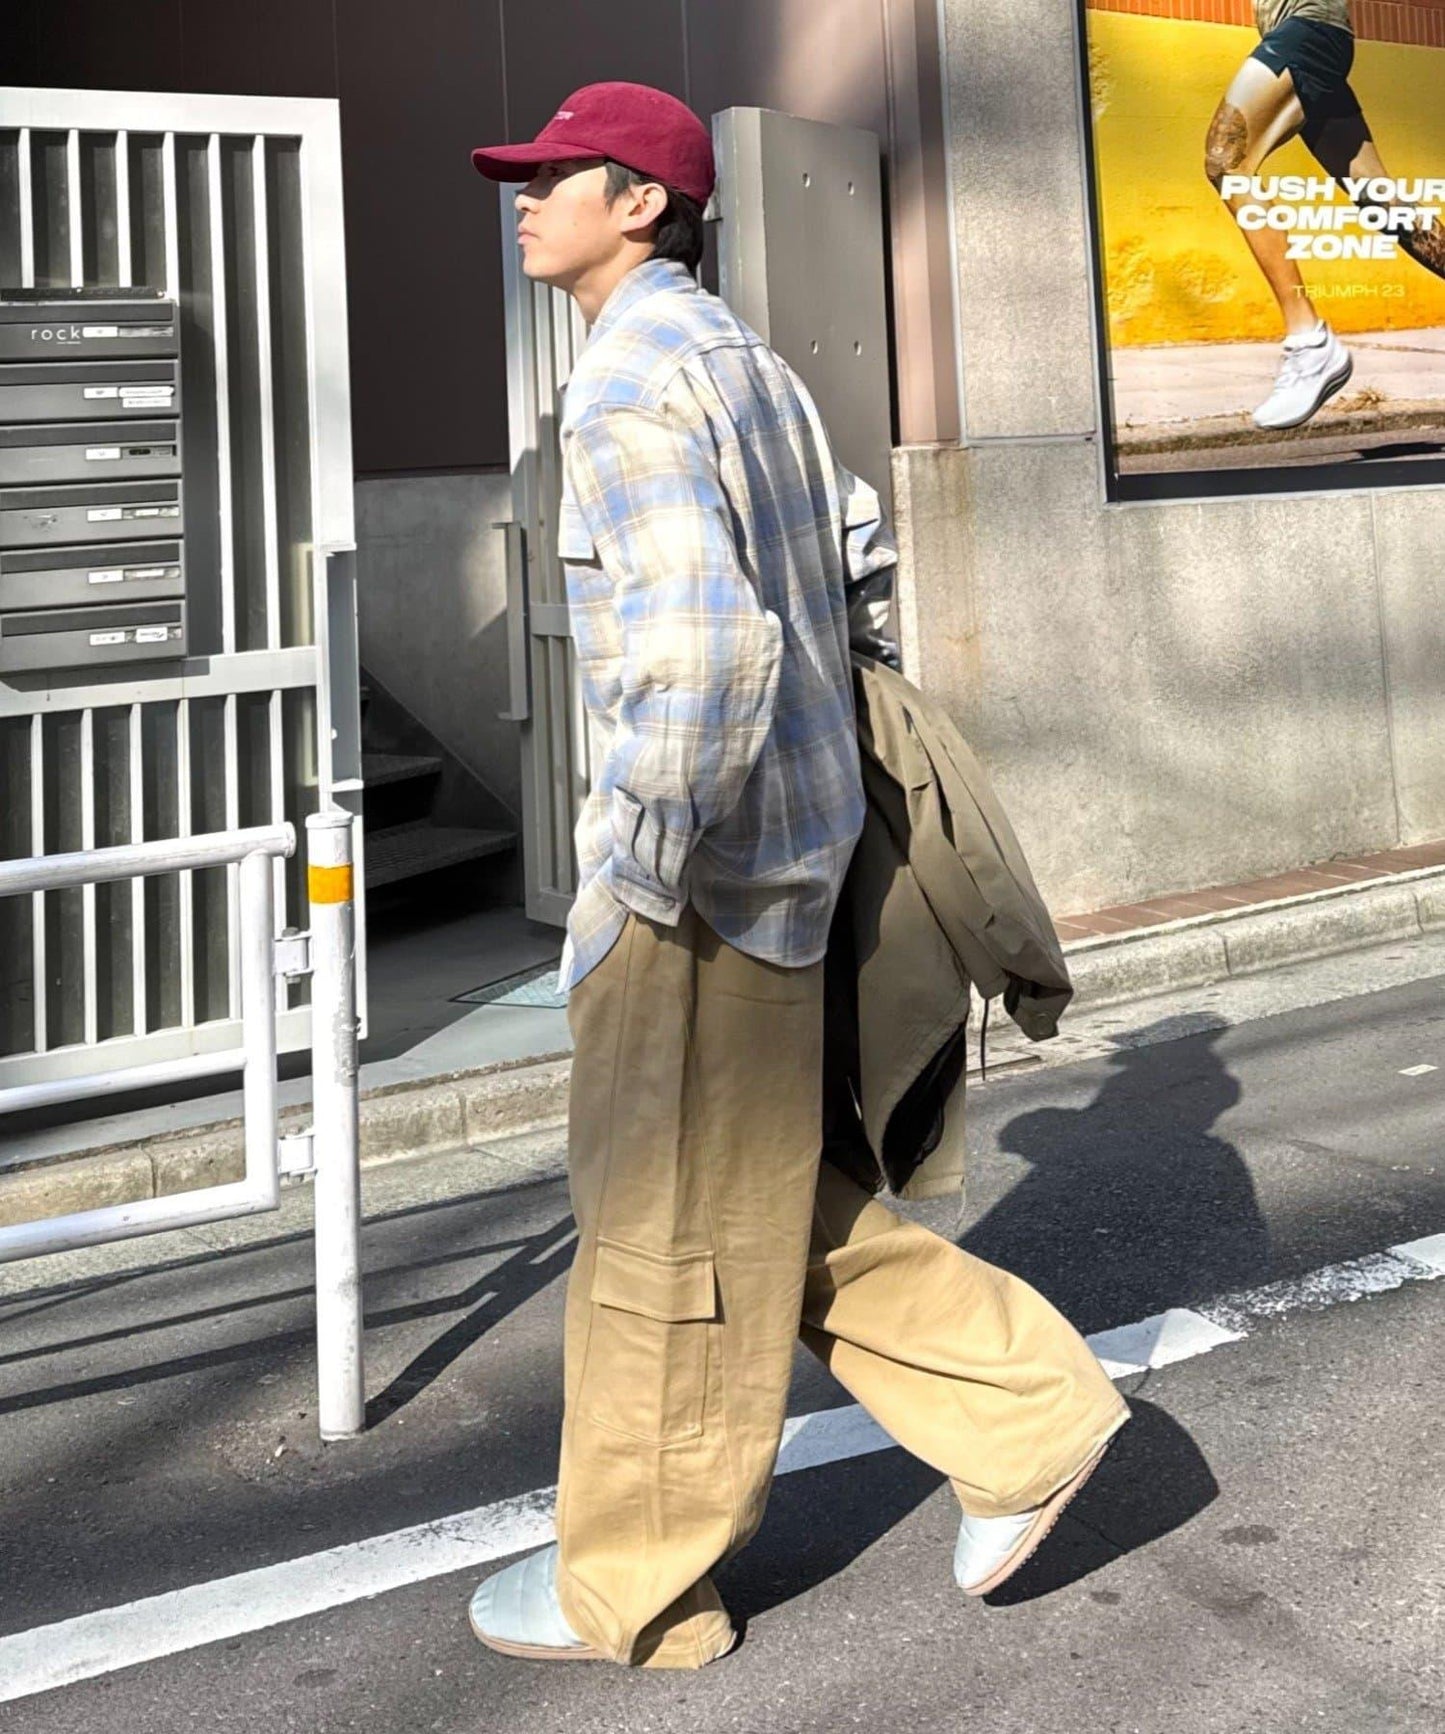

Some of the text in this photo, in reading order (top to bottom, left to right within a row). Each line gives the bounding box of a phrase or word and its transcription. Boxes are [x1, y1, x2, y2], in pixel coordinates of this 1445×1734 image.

[1221, 175, 1445, 202] PUSH YOUR
[1236, 204, 1442, 231] COMFORT
[1284, 234, 1399, 260] ZONE
[1292, 284, 1406, 298] TRIUMPH 23
[31, 326, 81, 341] rock
